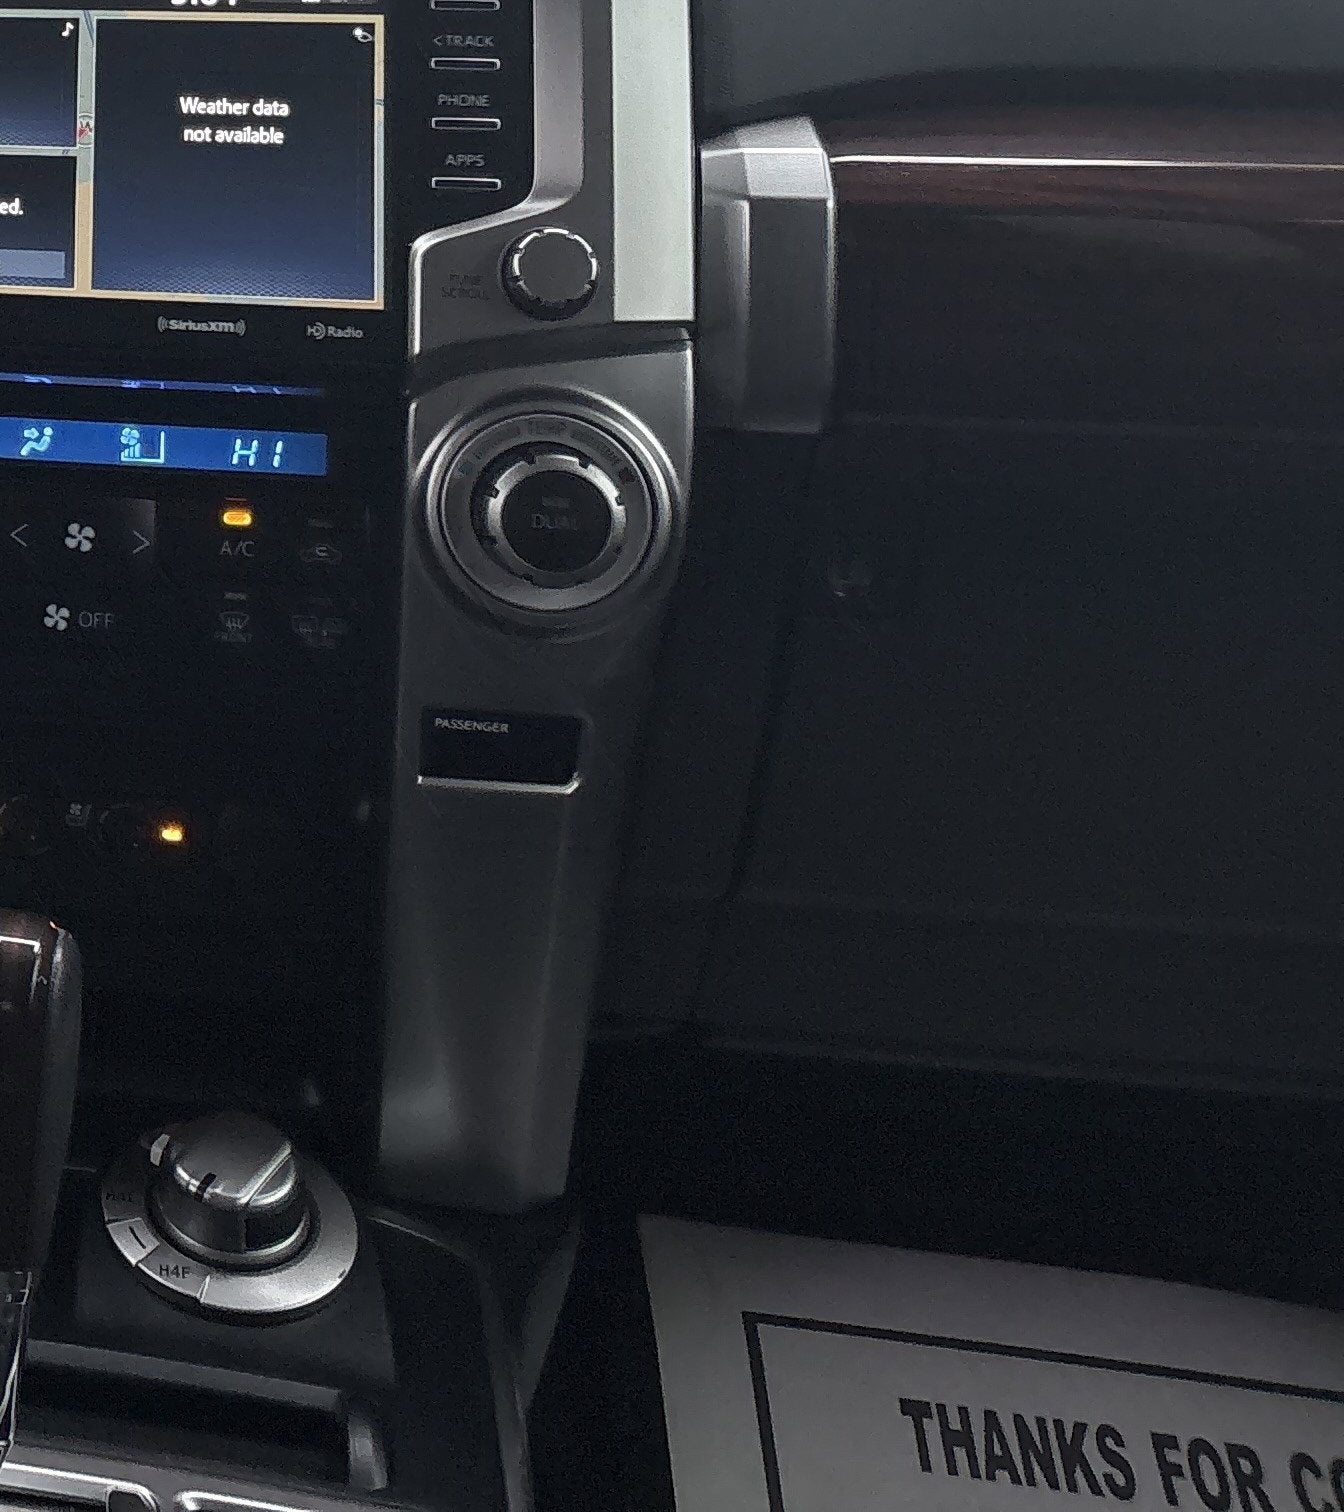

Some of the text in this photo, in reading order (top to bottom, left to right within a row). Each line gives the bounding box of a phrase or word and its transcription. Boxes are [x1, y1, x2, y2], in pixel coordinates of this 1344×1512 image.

[179, 96, 289, 116] Weather data
[437, 94, 491, 107] PHONE
[183, 126, 284, 144] not available
[445, 153, 485, 167] APPS
[327, 326, 363, 338] Radio
[220, 539, 255, 557] A/C
[78, 610, 114, 628] OFF
[434, 717, 510, 734] PASSENGER
[158, 1263, 191, 1279] H4F
[898, 1397, 1136, 1504] THANKS
[1149, 1430, 1278, 1512] FOR
